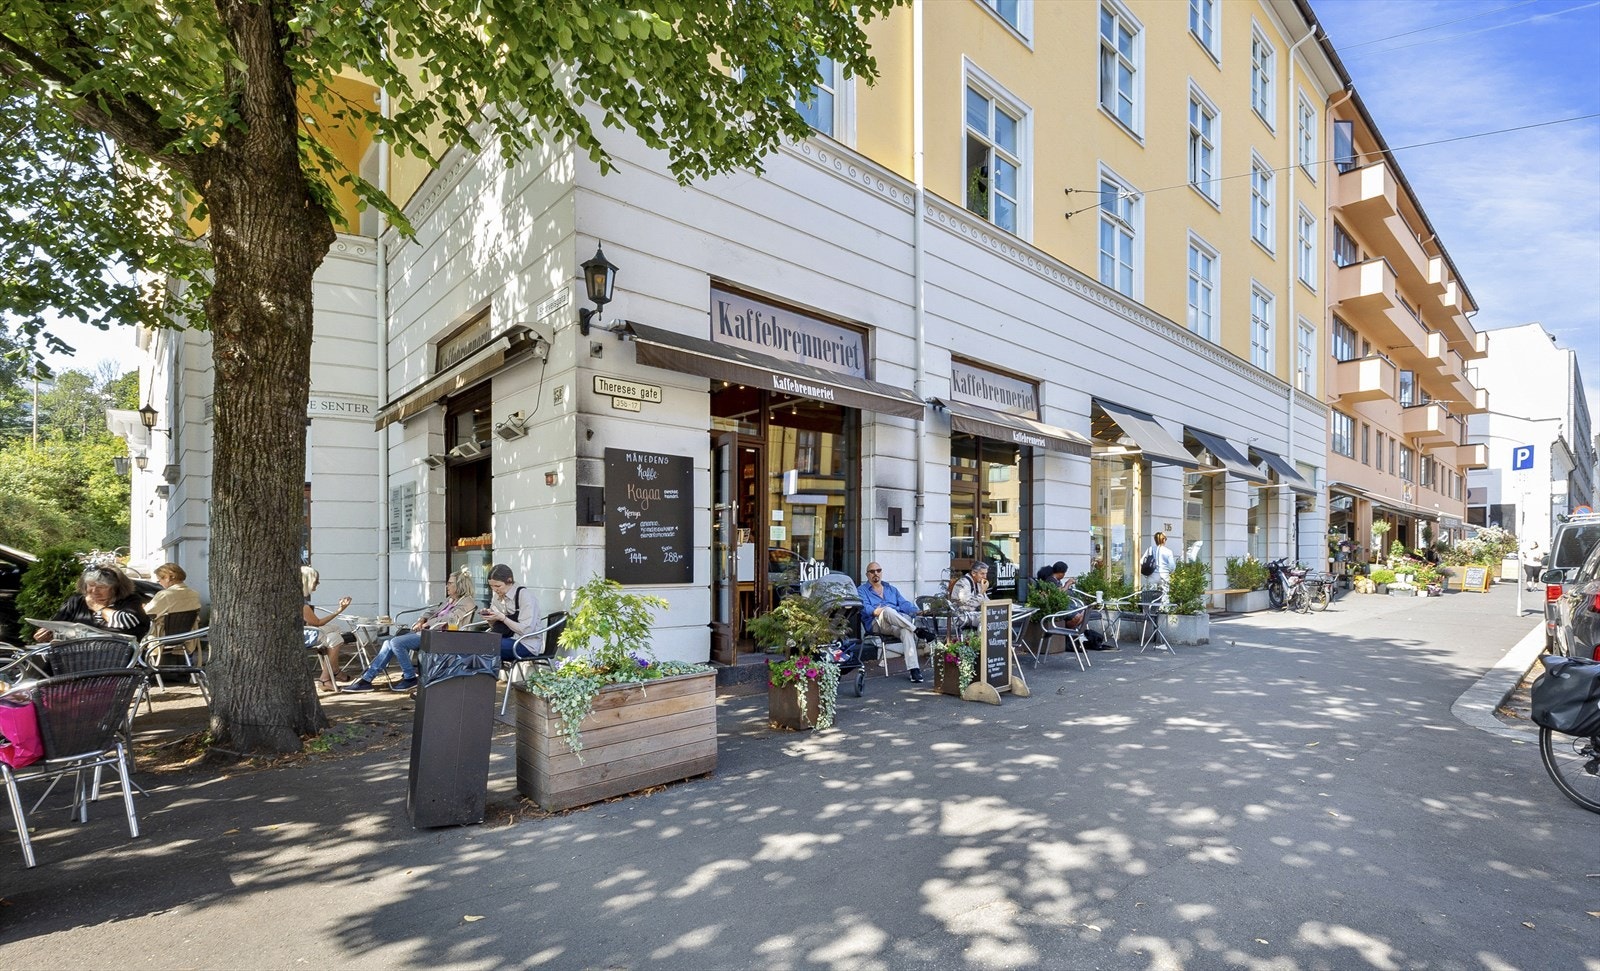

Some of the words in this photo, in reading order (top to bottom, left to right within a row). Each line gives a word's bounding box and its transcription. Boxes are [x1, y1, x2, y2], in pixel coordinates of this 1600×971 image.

[718, 300, 861, 370] Kaffebrenneriet
[599, 379, 636, 396] Thereses
[640, 388, 658, 399] gate
[772, 375, 834, 400] Kaffebrenneriet
[952, 368, 1036, 412] Kaffebrenneriet
[321, 400, 370, 414] SENTER
[626, 452, 669, 465] MÅNEDENS
[1516, 448, 1530, 468] P
[799, 561, 830, 582] Kaffe
